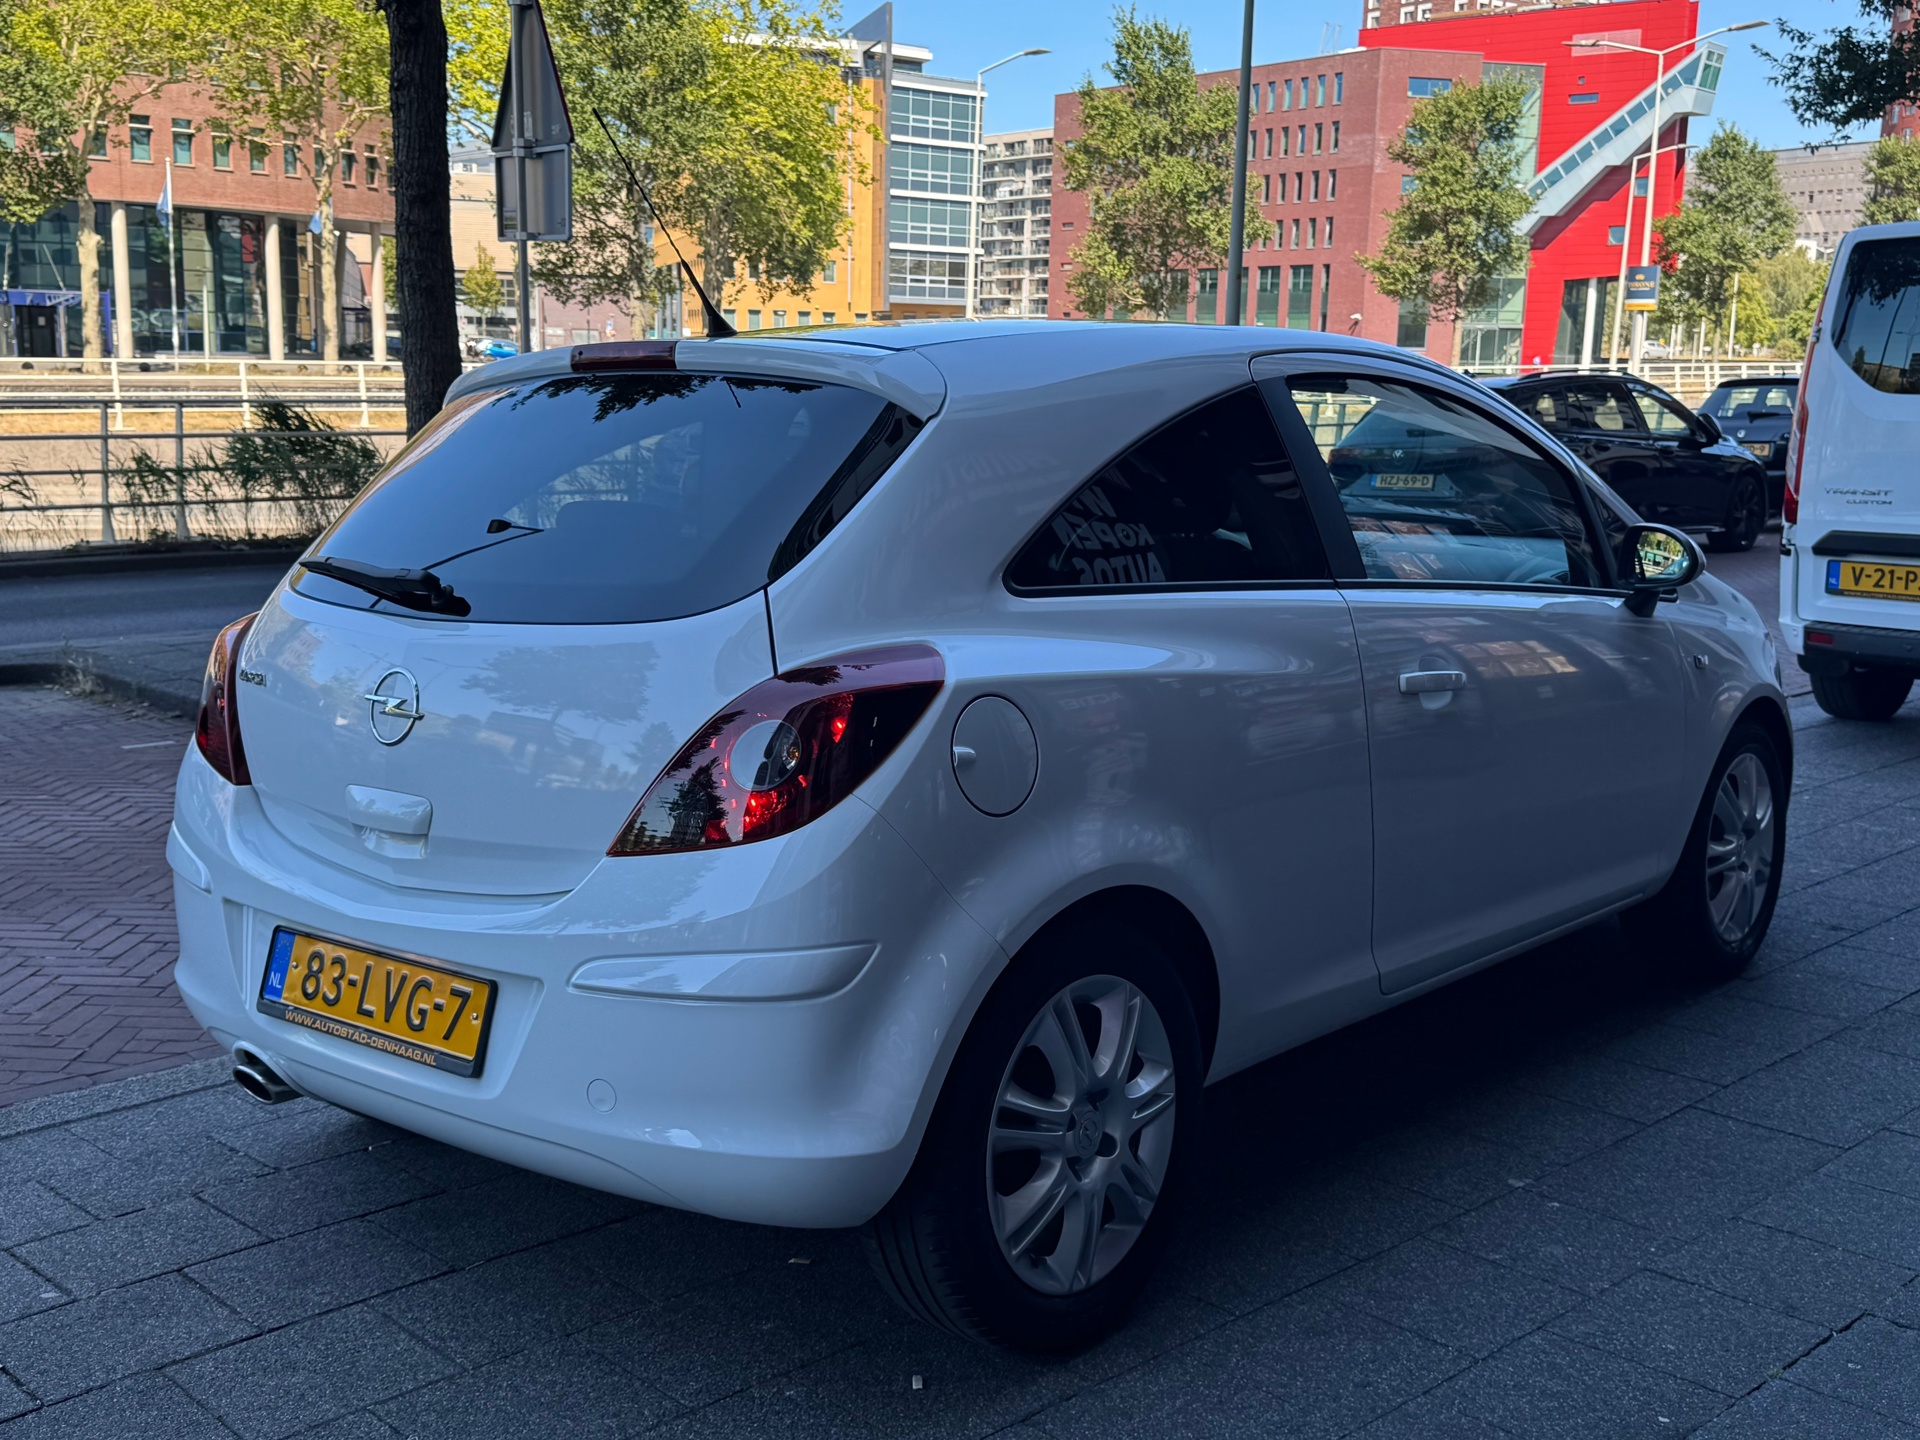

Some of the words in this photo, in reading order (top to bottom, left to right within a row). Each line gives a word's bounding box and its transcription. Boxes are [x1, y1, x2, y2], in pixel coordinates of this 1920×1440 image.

[1380, 475, 1430, 486] HZJ-69-D
[1851, 566, 1920, 592] V-21-P
[268, 970, 282, 989] NL
[301, 947, 473, 1041] 83-LVG-7
[285, 1010, 437, 1066] WWW.AUTOSTAD-DENHAAG.NL
